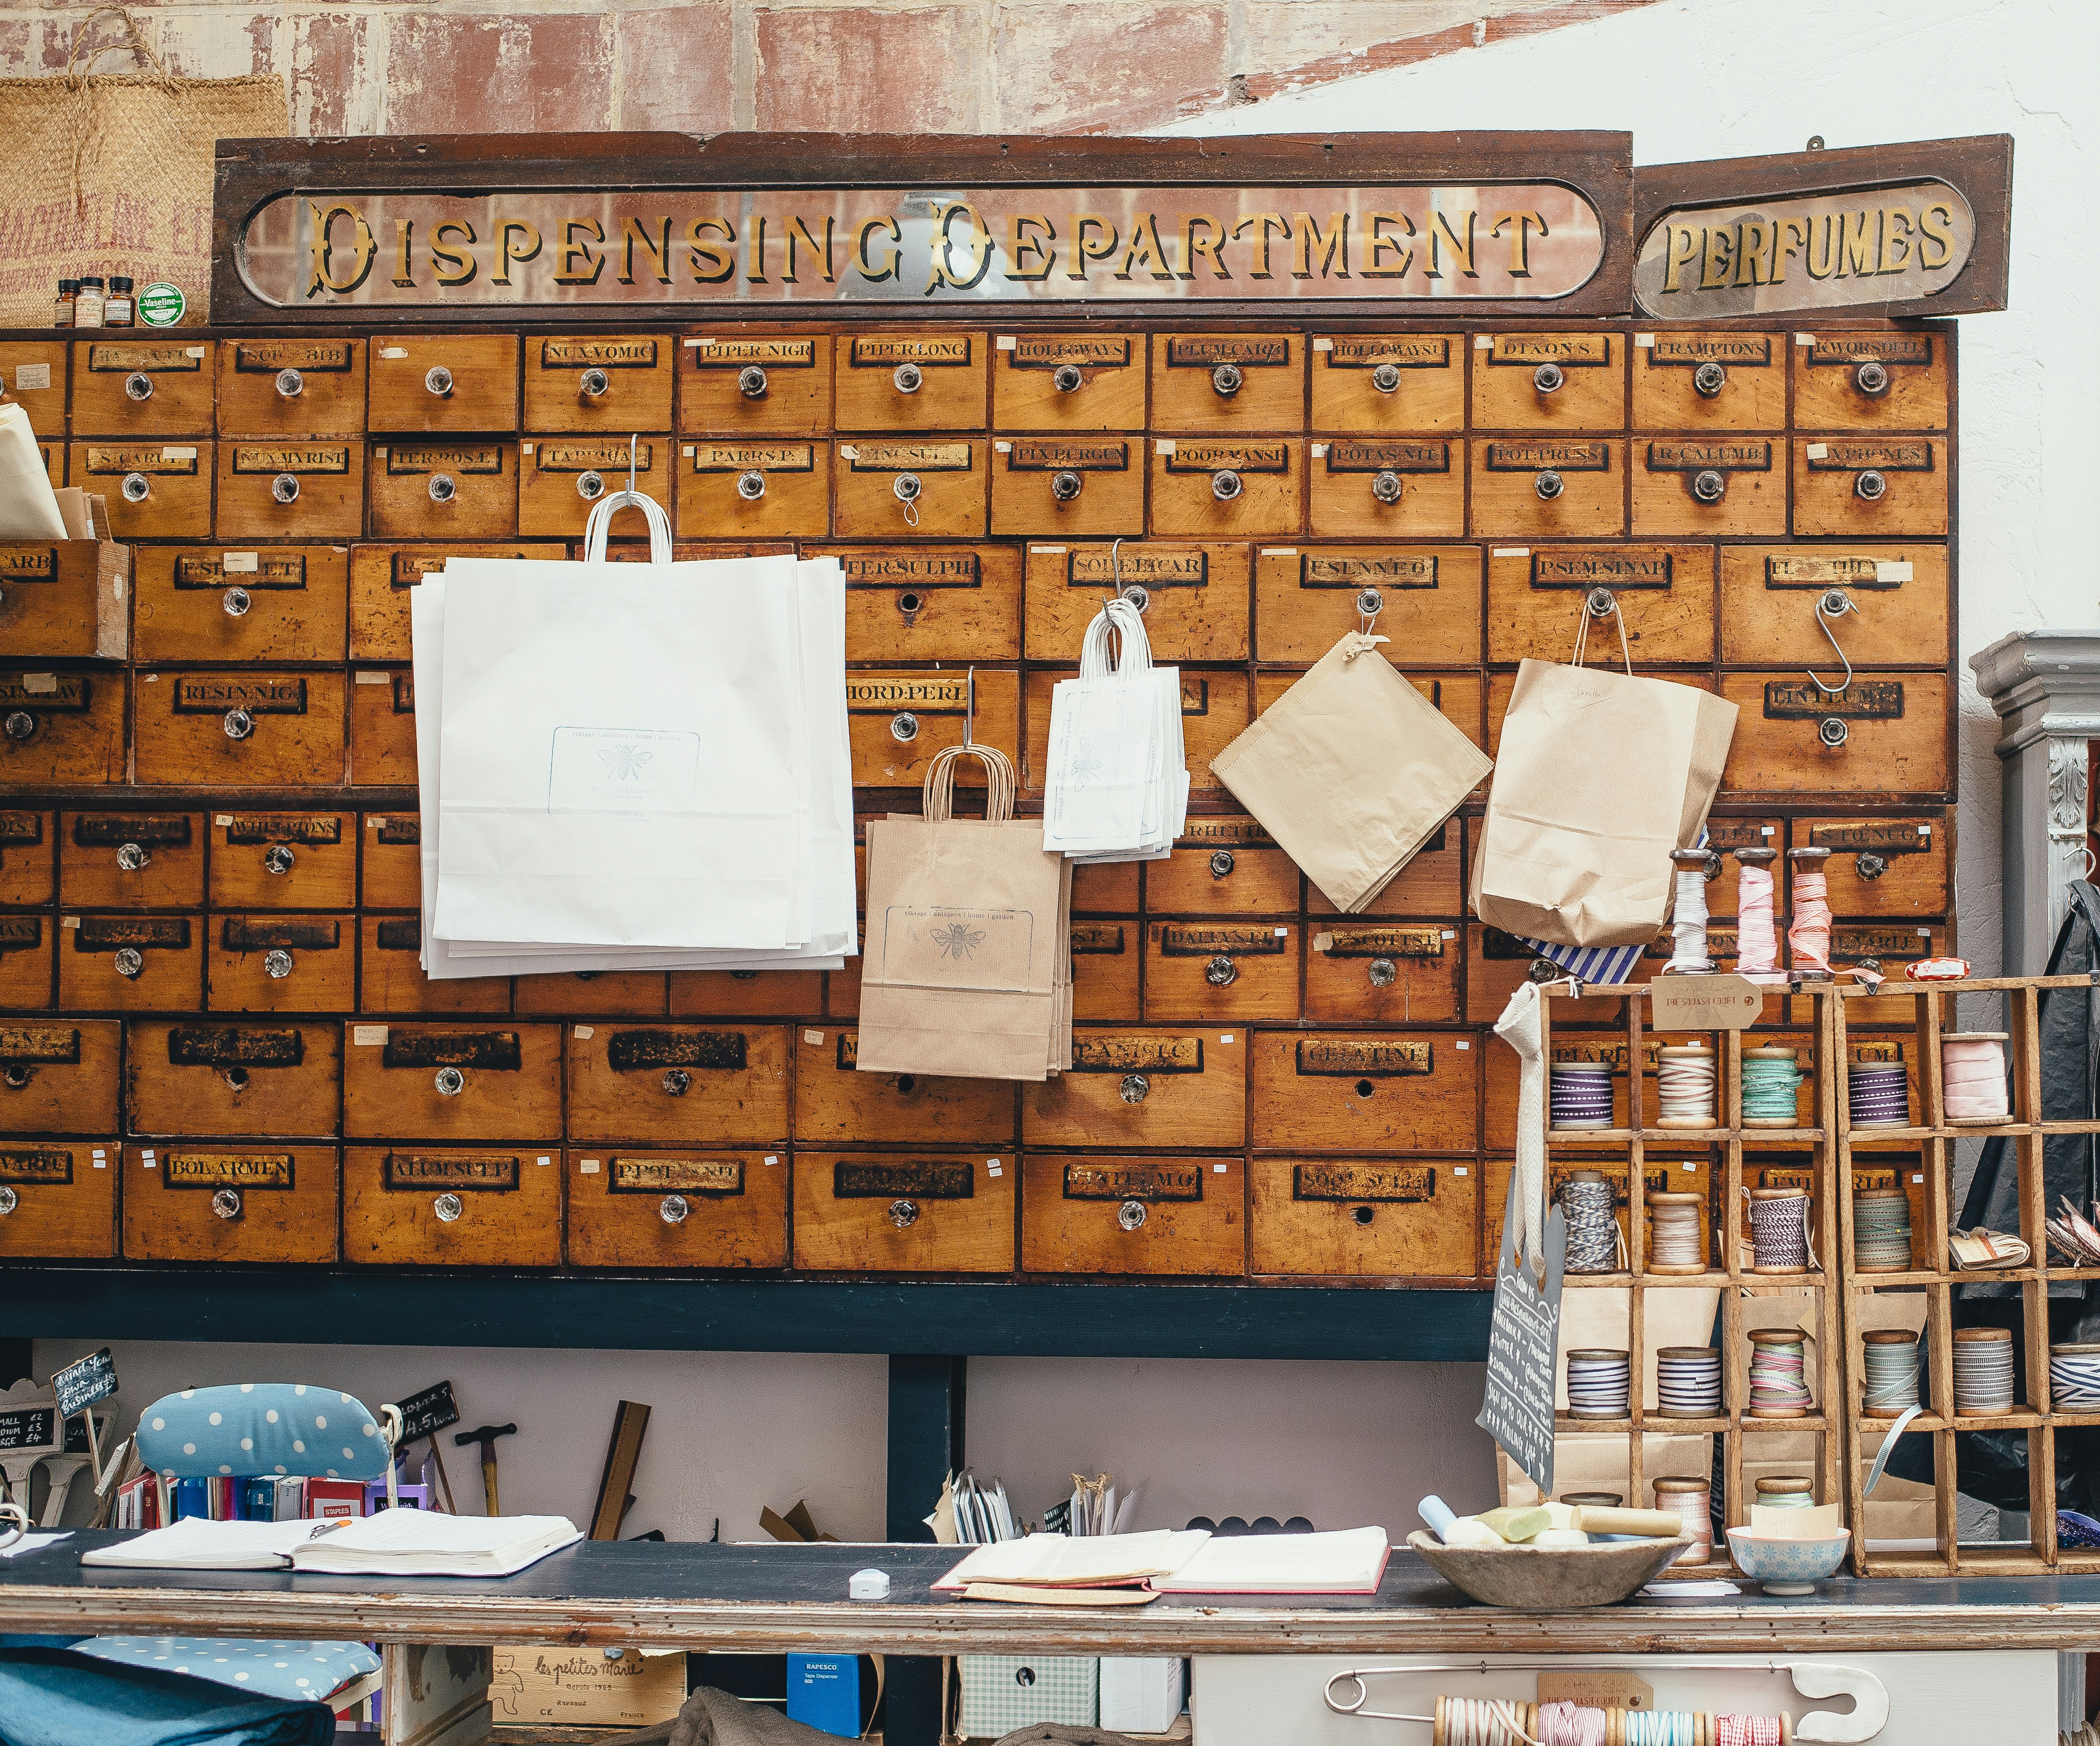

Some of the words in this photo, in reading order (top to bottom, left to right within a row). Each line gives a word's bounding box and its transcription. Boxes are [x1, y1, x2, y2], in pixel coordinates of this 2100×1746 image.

[306, 202, 904, 299] DISPENSING
[923, 197, 1548, 296] DEPARTMENT
[1660, 202, 1954, 295] PERFUMES
[144, 298, 176, 307] Vaseline
[28, 1423, 41, 1431] £3
[26, 1434, 41, 1442] £4
